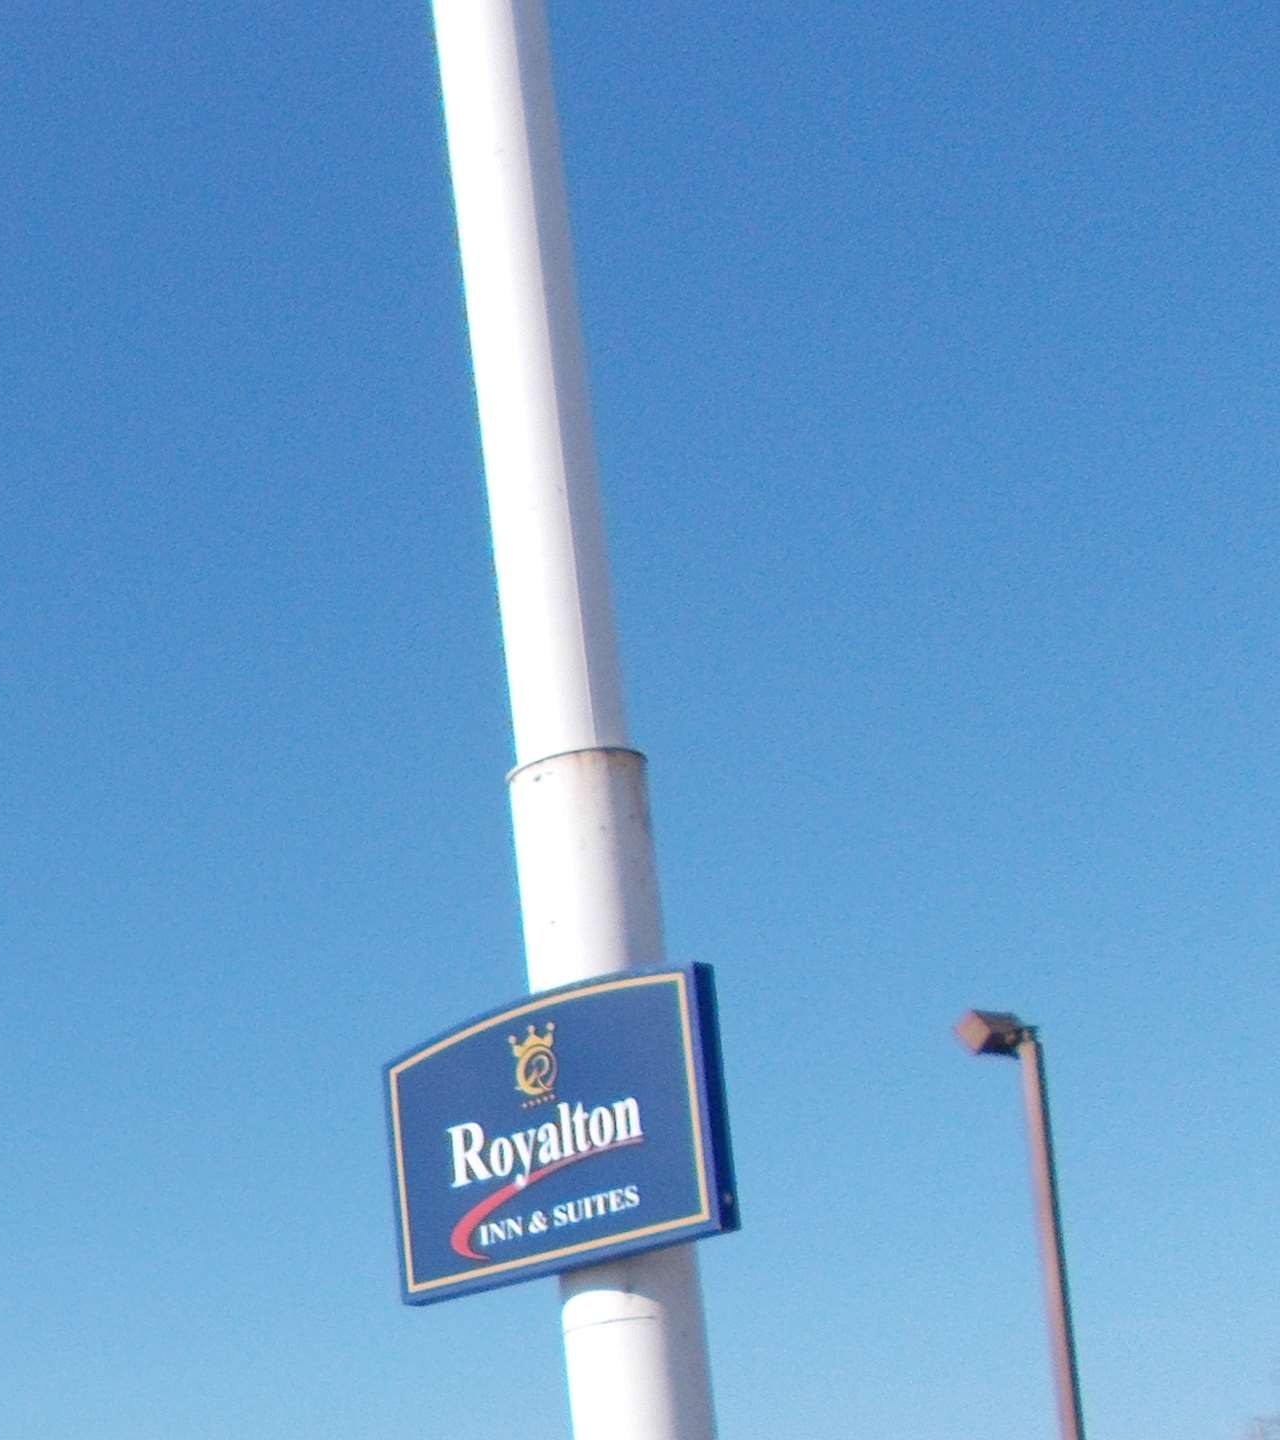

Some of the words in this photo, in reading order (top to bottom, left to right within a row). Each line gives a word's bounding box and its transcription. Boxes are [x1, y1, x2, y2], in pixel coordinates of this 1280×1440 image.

[447, 1096, 643, 1188] Royalton
[480, 1213, 523, 1246] INN
[527, 1210, 550, 1234] &
[554, 1184, 641, 1228] SUITES
